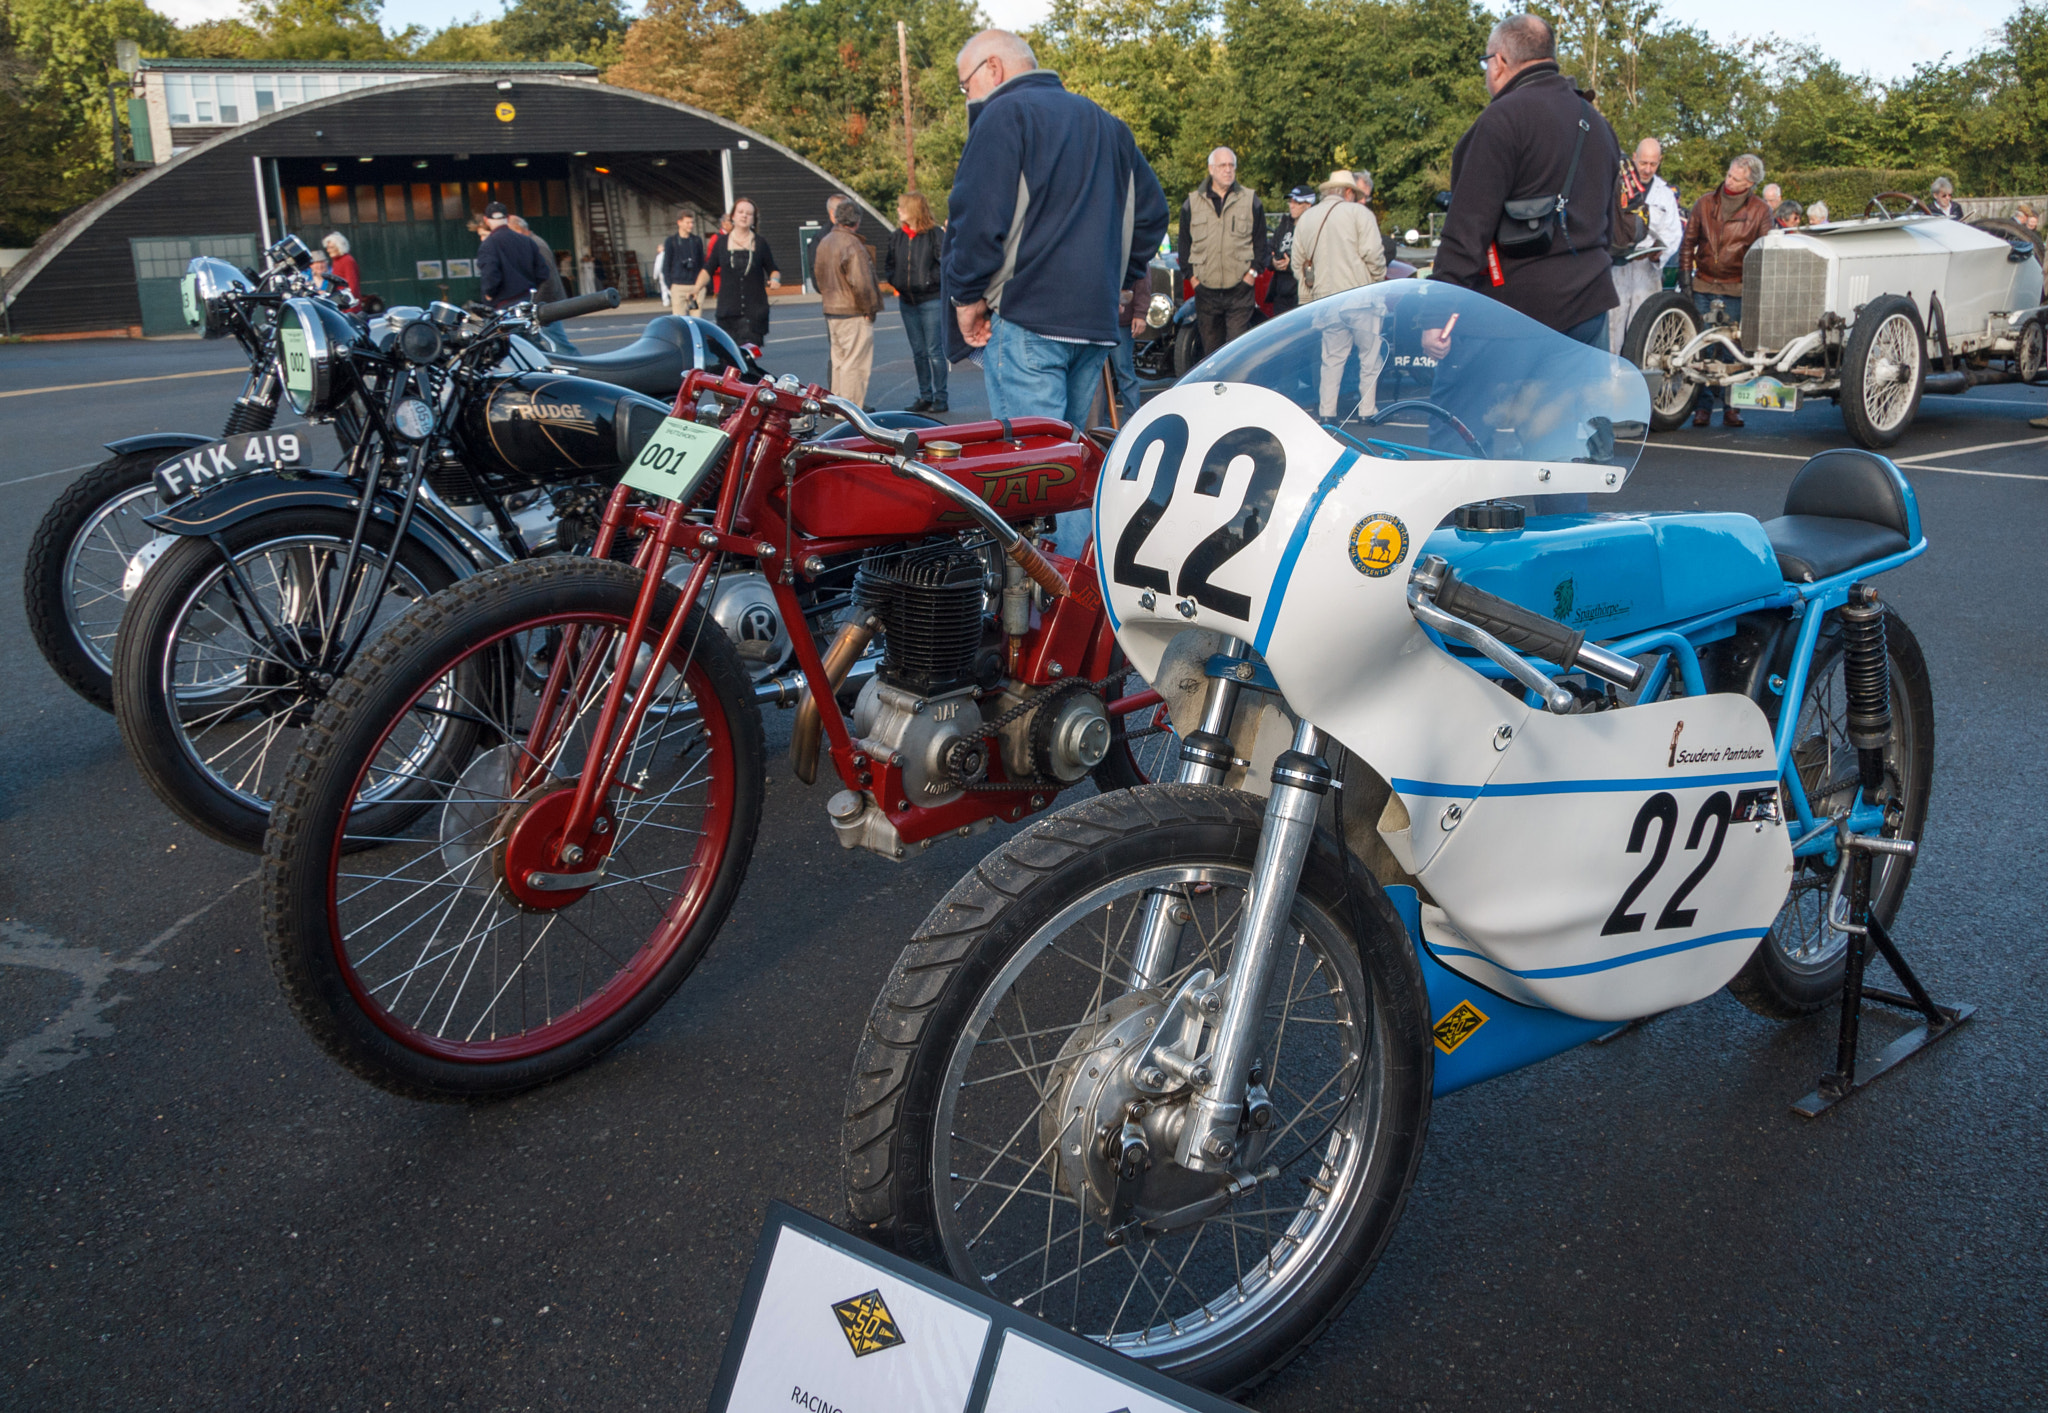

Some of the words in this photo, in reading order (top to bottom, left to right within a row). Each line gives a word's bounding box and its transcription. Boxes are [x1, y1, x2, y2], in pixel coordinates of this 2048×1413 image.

[519, 404, 585, 420] RUDGE
[160, 444, 237, 495] FKK
[244, 434, 300, 465] 419
[640, 443, 687, 475] 001
[1114, 413, 1286, 622] 22
[748, 610, 774, 641] R
[933, 702, 960, 721] JAP
[1676, 748, 1720, 763] Scuderia
[1722, 745, 1764, 761] Pantalone
[1600, 788, 1732, 937] 22
[852, 1309, 881, 1338] 50
[791, 1385, 844, 1413] RACIN
